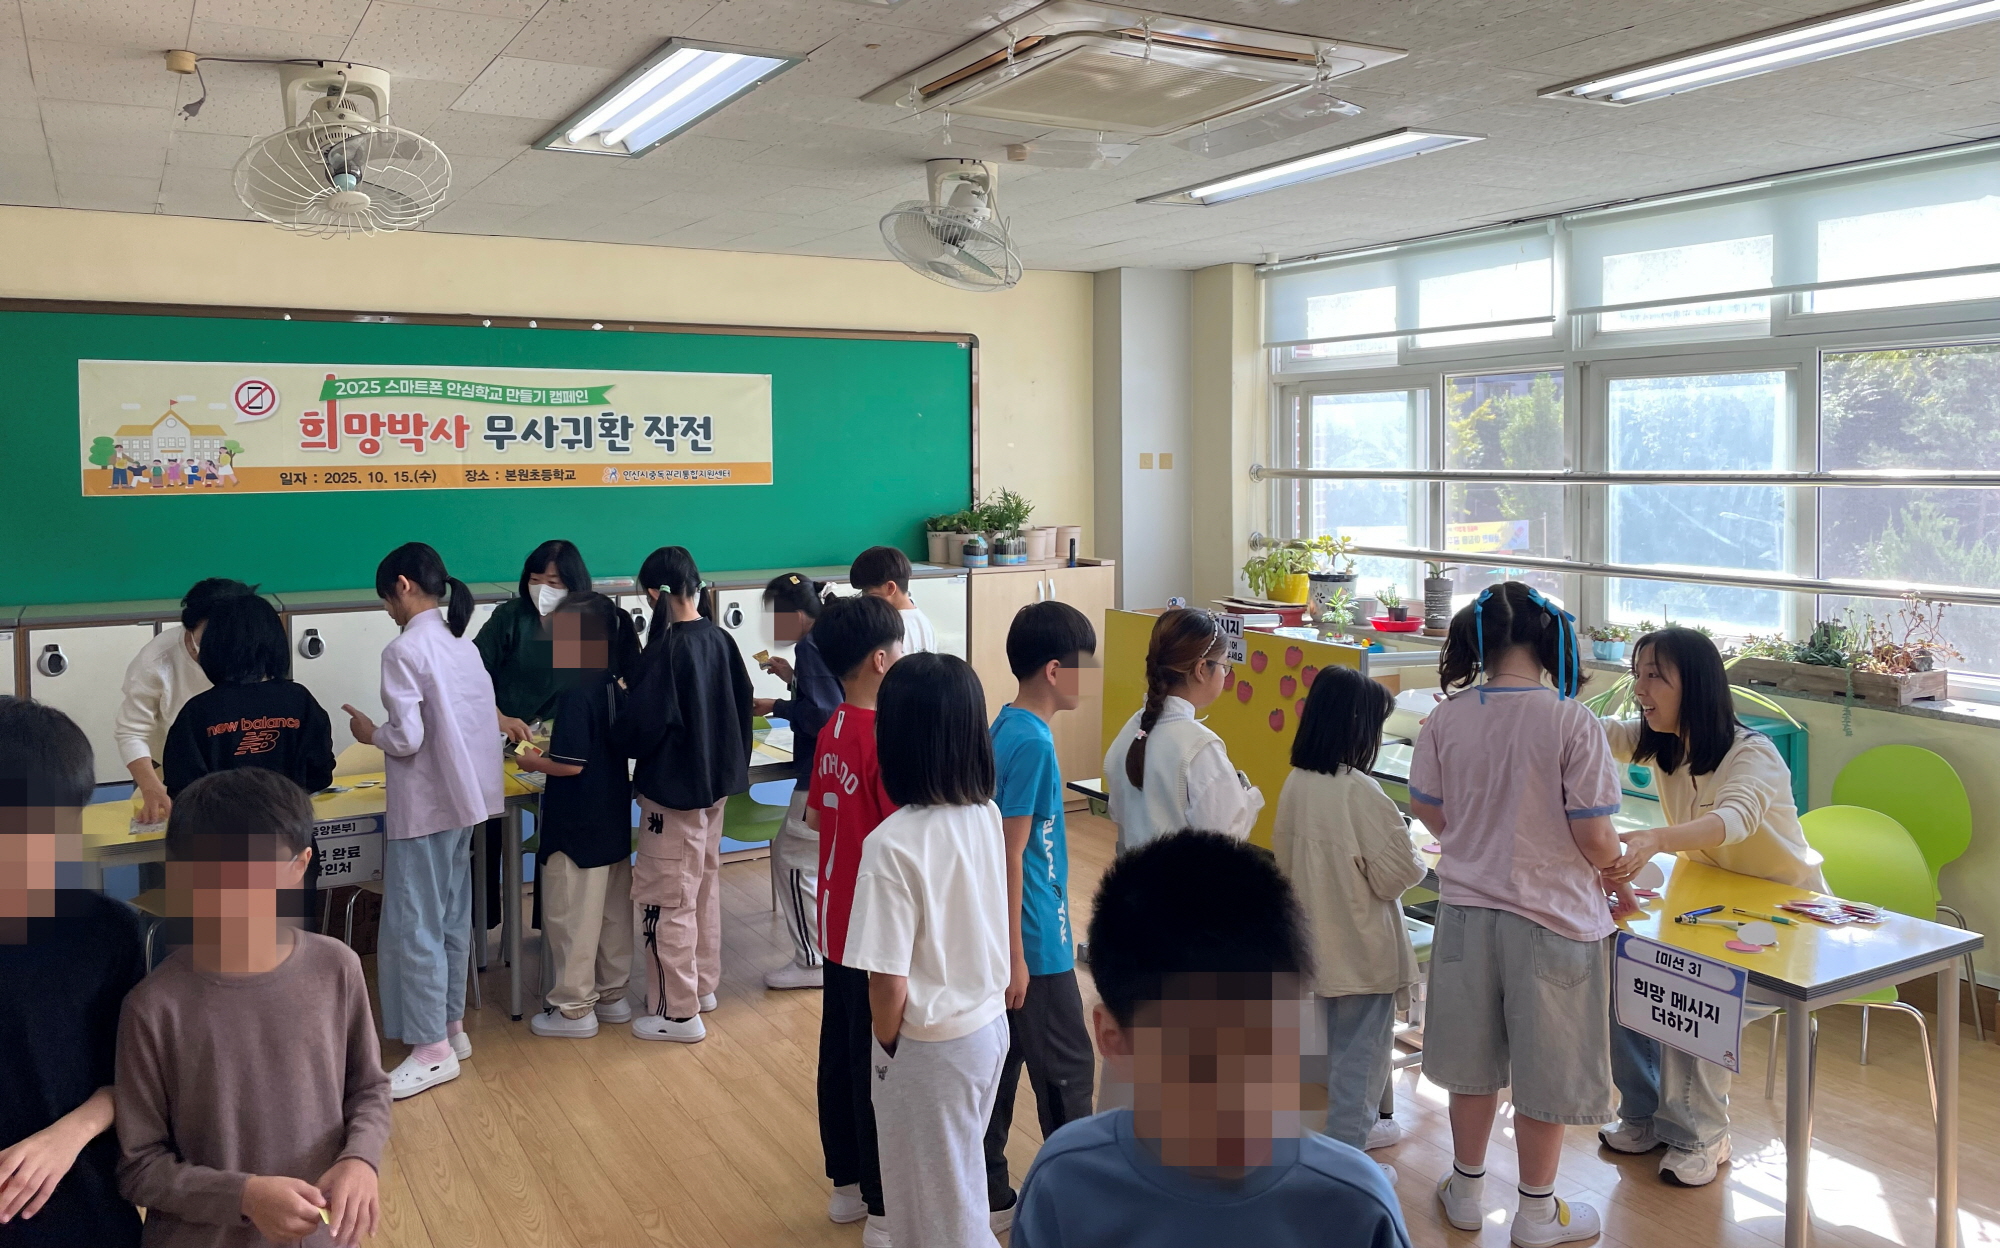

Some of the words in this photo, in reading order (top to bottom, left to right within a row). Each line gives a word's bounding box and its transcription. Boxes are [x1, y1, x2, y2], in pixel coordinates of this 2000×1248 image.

[335, 380, 382, 397] 2025
[385, 380, 443, 396] 스마트폰
[447, 382, 503, 401] 안심학교
[506, 389, 546, 404] 만들기
[549, 389, 589, 404] 캠페인
[299, 374, 470, 454] 희망박사
[483, 412, 634, 453] 무사귀환
[643, 415, 712, 453] 작전
[279, 471, 307, 486] 일자
[324, 472, 361, 485] 2025.
[368, 472, 388, 484] 10.
[464, 469, 490, 482] 장소
[504, 468, 577, 482] 본원초등학교
[207, 721, 239, 738] new
[241, 716, 300, 731] balance
[332, 845, 361, 860] 완료
[1656, 950, 1684, 972] [미션
[1688, 962, 1702, 978] 3]
[1634, 978, 1665, 1003] 희망
[1671, 991, 1719, 1025] 메시지
[1652, 1005, 1699, 1039] 더하기
